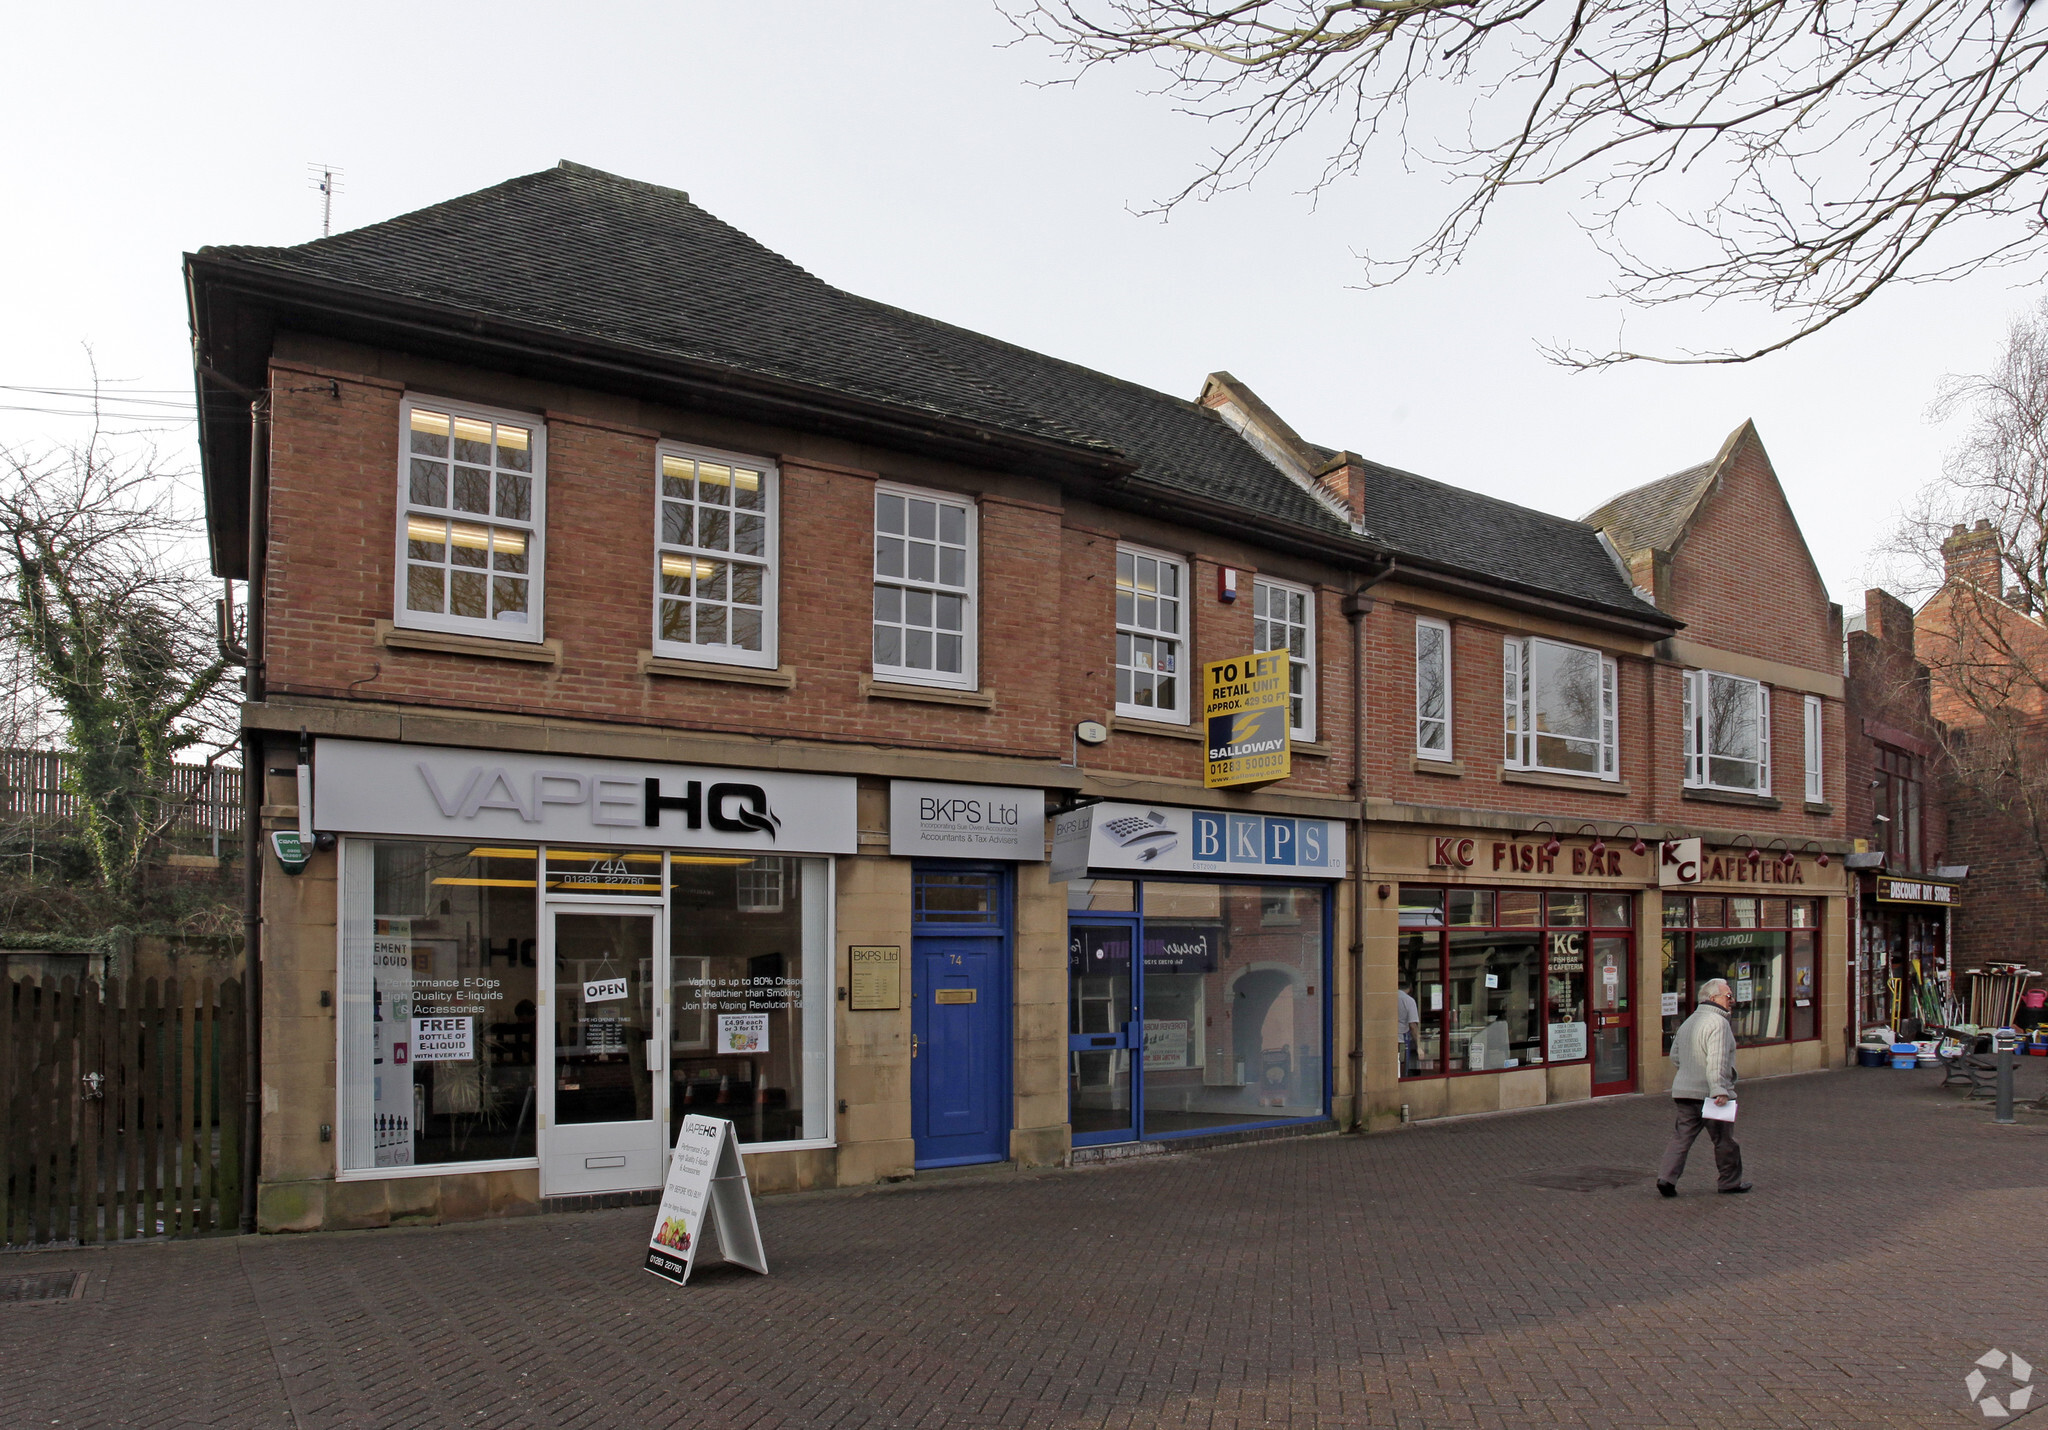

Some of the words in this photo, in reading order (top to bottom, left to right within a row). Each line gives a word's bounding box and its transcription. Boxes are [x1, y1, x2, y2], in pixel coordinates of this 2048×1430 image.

[1212, 664, 1238, 684] TO
[1245, 655, 1280, 679] LET
[1213, 684, 1250, 700] RETAIL
[1253, 678, 1279, 693] UNIT
[1207, 700, 1242, 713] APPROX.
[1244, 697, 1259, 706] 429
[1262, 694, 1273, 704] SQ
[1276, 692, 1286, 701] FT
[1209, 739, 1283, 759] SALLOWAY
[1211, 761, 1241, 775] 01283
[1246, 755, 1283, 770] 500030
[1211, 769, 1282, 783] www.salloway.com
[920, 798, 981, 823] BKPS
[989, 802, 1018, 825] Ltd
[1056, 819, 1077, 836] BKPS
[920, 832, 965, 842] Accountants
[967, 834, 972, 842] &
[975, 834, 986, 842] Tax
[989, 836, 1018, 844] Advisers
[1430, 837, 1474, 868] KC
[1493, 842, 1554, 874] FISH
[1573, 848, 1623, 876] BAR
[588, 858, 628, 874] 74A
[1329, 859, 1340, 868] LTD
[1702, 855, 1805, 883] CAFETERIA
[564, 875, 598, 884] 01283
[604, 876, 645, 885] 227760
[1890, 881, 1921, 900] DISCOUNT
[1923, 884, 1933, 900] DIY
[1934, 886, 1951, 902] STORE
[1553, 934, 1579, 955] KC
[853, 950, 882, 961] BKPS
[883, 950, 898, 961] Ltd
[950, 954, 962, 965] 74
[1554, 963, 1583, 971] CAFETERIA
[384, 977, 459, 987] Performance
[463, 977, 500, 988] E-Cigs
[688, 978, 716, 987] Vaping
[719, 977, 726, 985] is
[728, 979, 739, 987] up
[753, 977, 773, 985] 80%
[382, 991, 407, 1002] High
[412, 991, 453, 1002] Quality
[456, 991, 503, 1001] E-liquids
[587, 983, 625, 997] OPEN
[704, 990, 743, 998] Healthier
[745, 989, 764, 997] than
[401, 1004, 409, 1014] &
[414, 1004, 485, 1014] Accessories
[682, 1002, 700, 1010] Join
[702, 1001, 717, 1009] the
[720, 1001, 747, 1011] Vaping
[749, 1001, 790, 1009] Revolution
[420, 1019, 466, 1031] FREE
[420, 1042, 466, 1050] E-LIQUID
